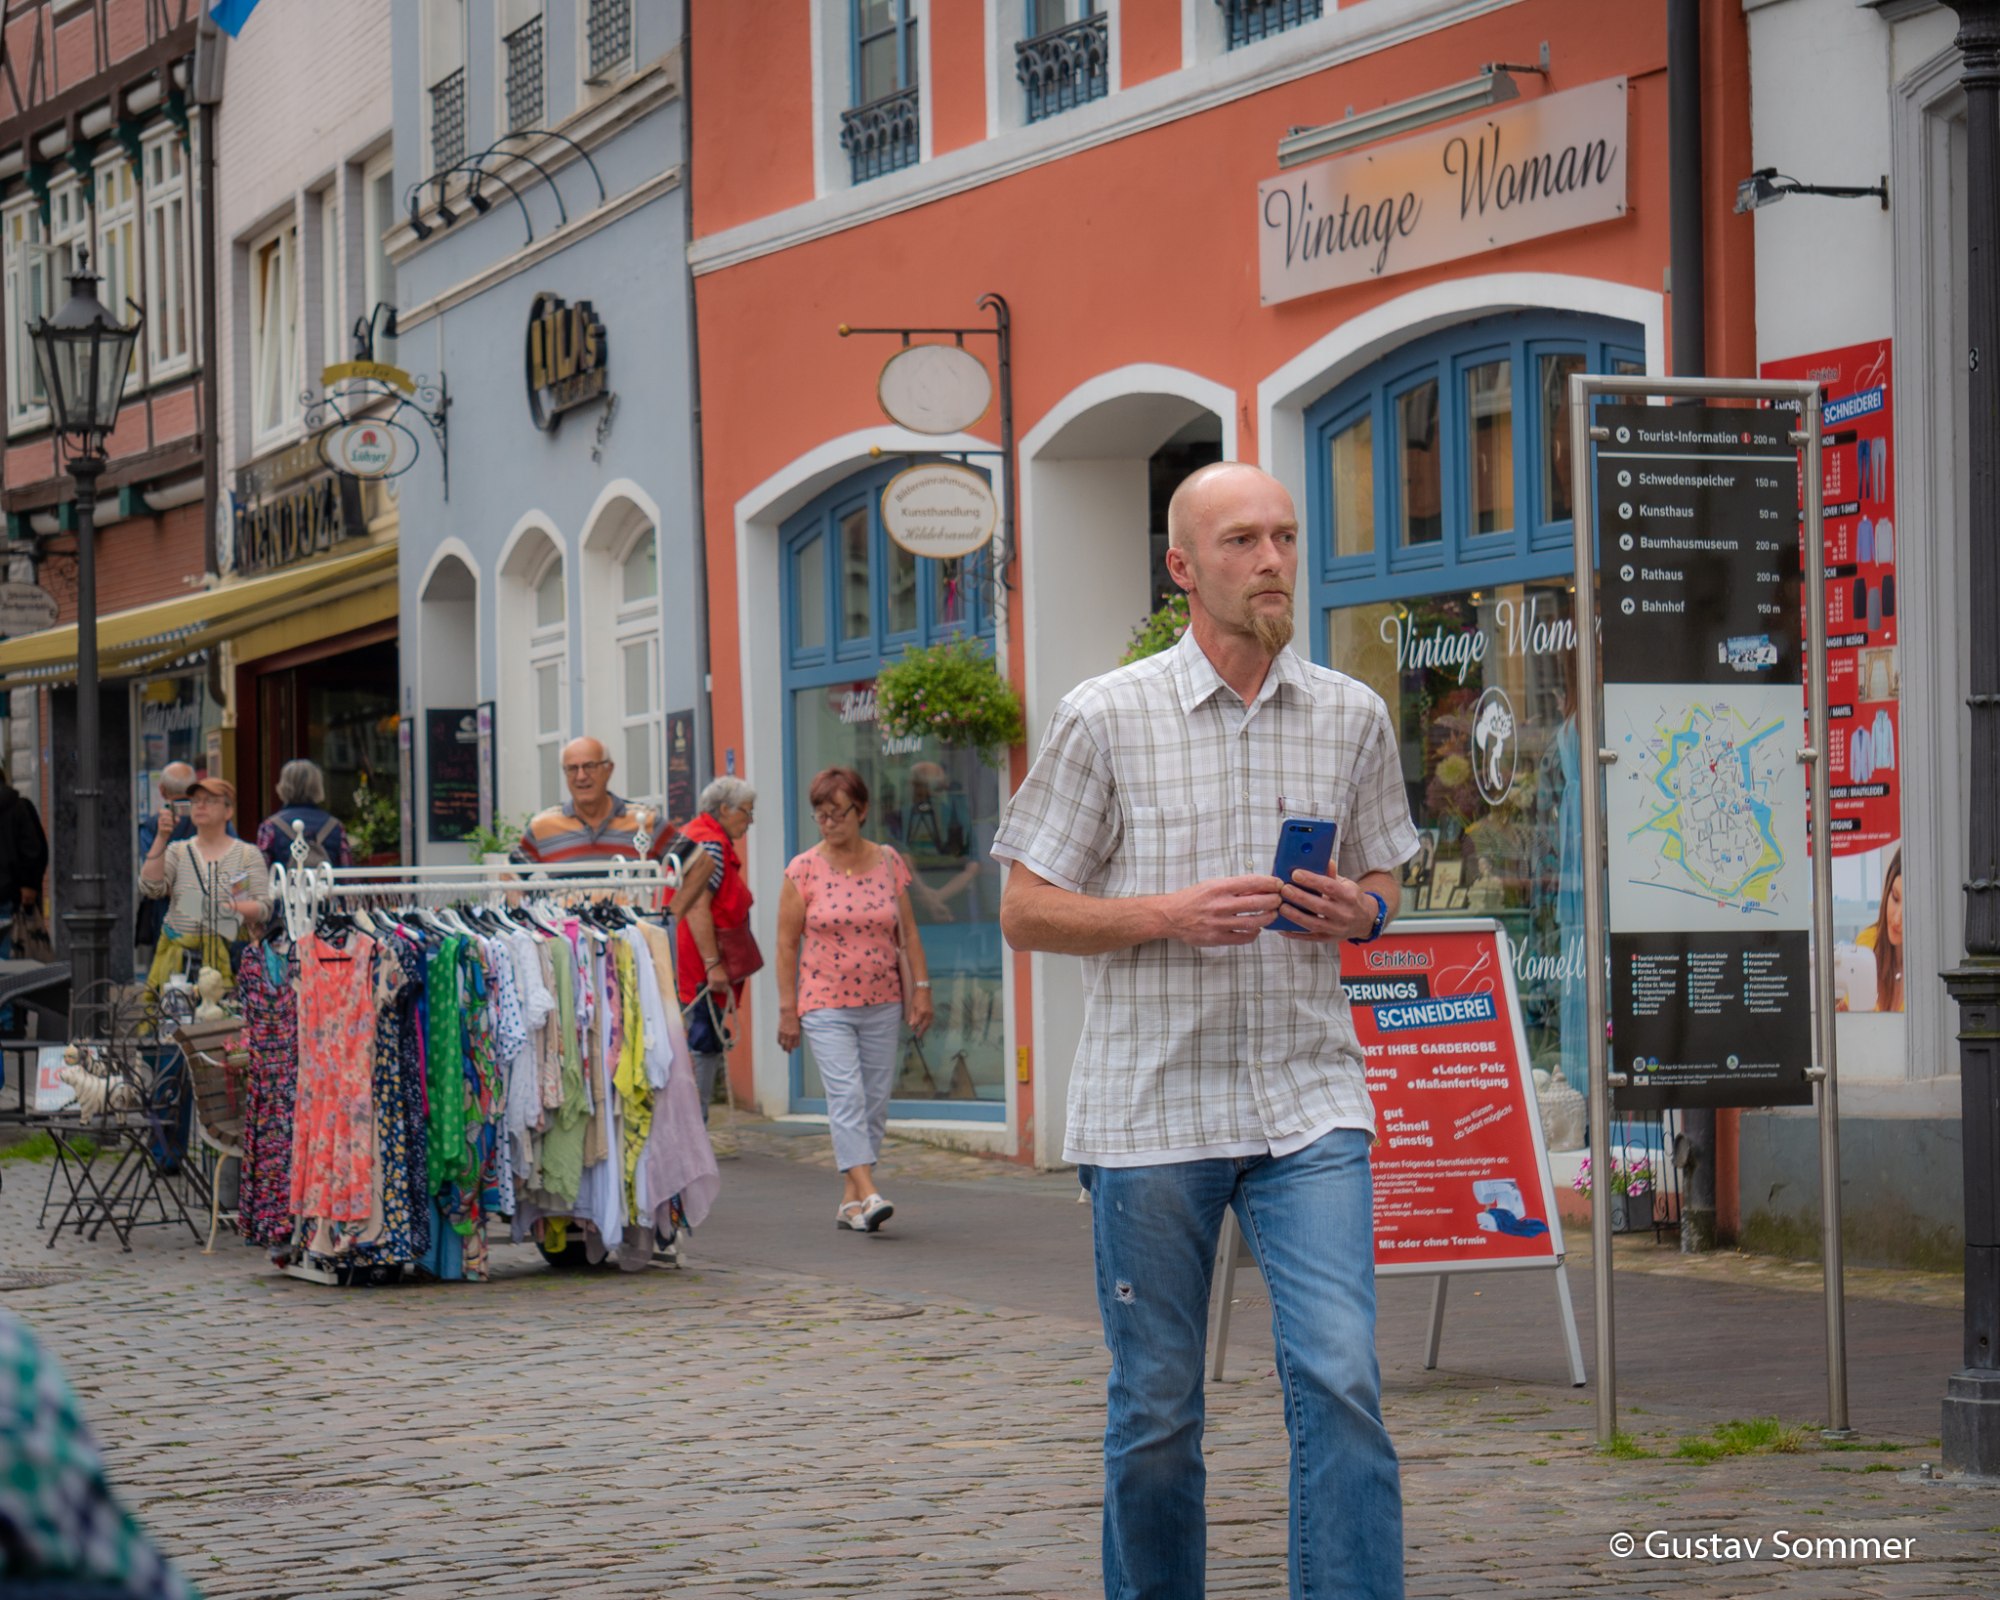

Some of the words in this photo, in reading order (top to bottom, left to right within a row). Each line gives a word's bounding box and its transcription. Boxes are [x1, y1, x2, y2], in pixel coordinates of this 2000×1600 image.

[1264, 180, 1423, 275] Vintage
[1443, 125, 1618, 221] Woman
[1824, 392, 1881, 424] SCHNEIDEREI
[1638, 429, 1738, 444] Tourist-Information
[1753, 435, 1767, 445] 200
[1639, 473, 1735, 488] Schwedenspeicher
[1755, 478, 1769, 487] 150
[901, 507, 980, 519] Kunsthandlung
[1639, 505, 1694, 517] Kunsthaus
[1759, 510, 1769, 519] 50
[1640, 537, 1738, 550] Baumhausmuseum
[1756, 541, 1770, 550] 200
[1641, 568, 1683, 581] Rathaus
[1757, 573, 1770, 582] 200
[1642, 600, 1685, 613] Bahnhof
[1757, 604, 1771, 613] 950
[1380, 612, 1489, 686] Vintage
[1370, 951, 1427, 967] Chikho
[1377, 998, 1491, 1029] SCHNEIDEREI
[1388, 1044, 1418, 1056] IHRE
[1421, 1041, 1496, 1054] GARDEROBE
[1480, 1063, 1505, 1074] Pelz
[1415, 1077, 1509, 1090] Maßanfertigung
[1383, 1107, 1404, 1121] gut
[1453, 1114, 1471, 1128] Hose
[1386, 1120, 1429, 1132] schnell
[1389, 1135, 1434, 1149] günstig
[1453, 1130, 1465, 1140] ab
[1436, 1157, 1496, 1168] Dienstleistungen
[1378, 1239, 1395, 1249] Mit
[1397, 1238, 1421, 1248] oder
[1423, 1237, 1449, 1247] ohne
[1451, 1235, 1487, 1246] Termin
